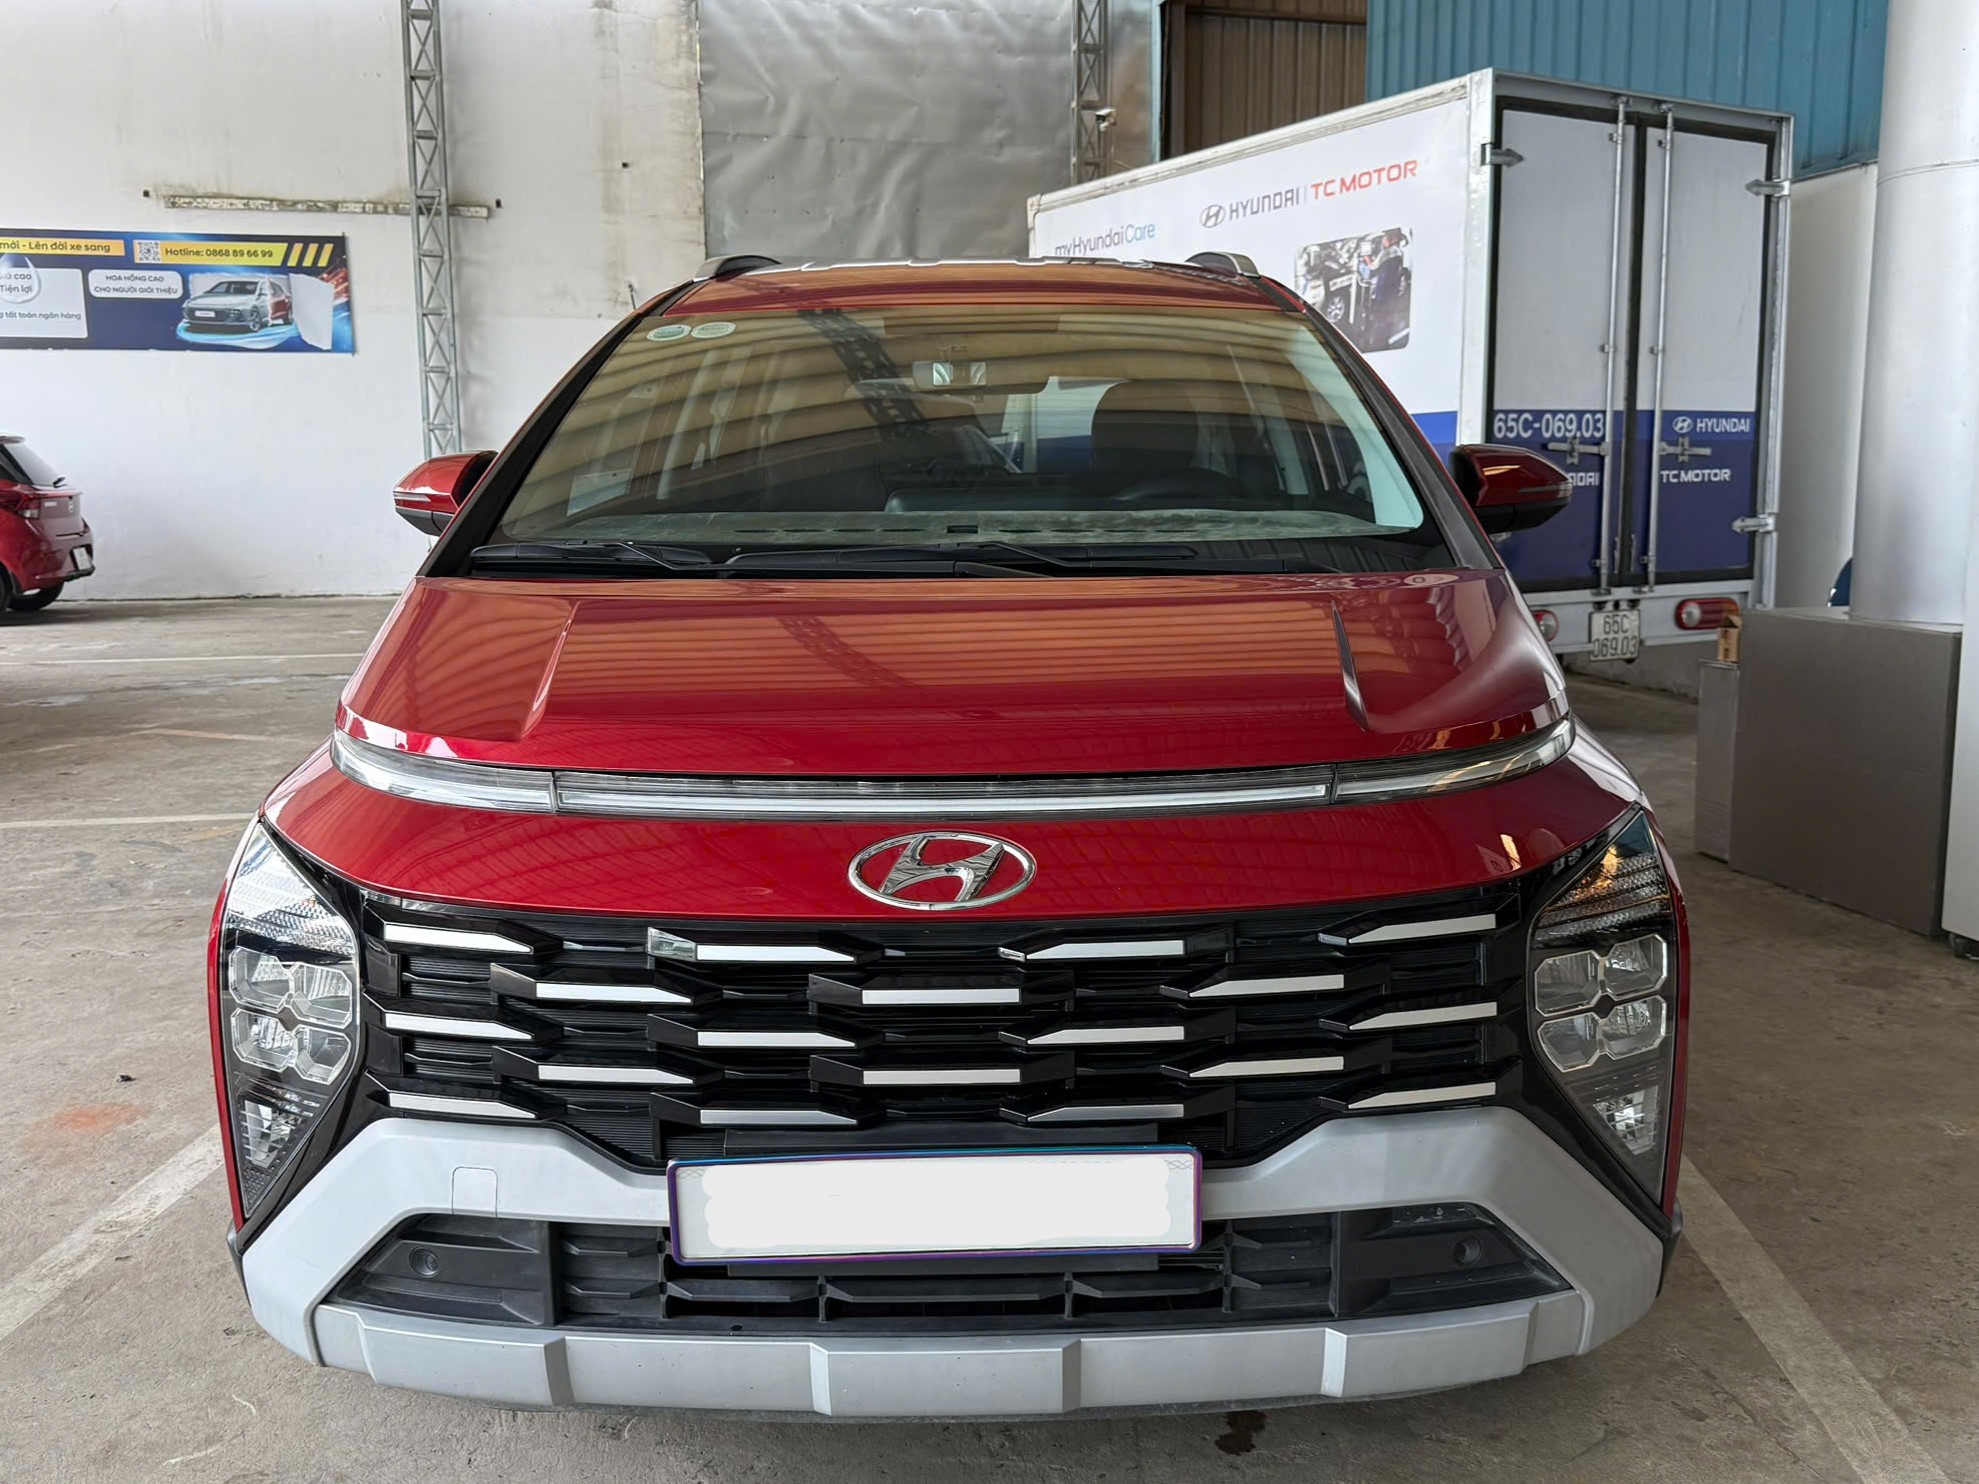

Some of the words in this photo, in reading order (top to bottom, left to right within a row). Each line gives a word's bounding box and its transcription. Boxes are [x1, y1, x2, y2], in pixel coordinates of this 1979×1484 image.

[1229, 187, 1300, 221] HYUNDAI
[1311, 179, 1336, 200] TC
[1340, 160, 1418, 195] MOTOR
[29, 241, 48, 251] Lên
[85, 244, 111, 253] sang
[165, 247, 204, 257] Hotline:
[205, 248, 231, 258] 0868
[232, 249, 245, 258] 89
[246, 249, 259, 258] 66
[260, 249, 273, 259] 99
[106, 274, 123, 282] HOA
[147, 275, 165, 283] CAO
[94, 285, 112, 293] CHO
[1493, 412, 1605, 440] 65C-069.03
[1695, 418, 1751, 433] HYUNDAI
[1660, 470, 1679, 484] TC
[1680, 468, 1732, 483] MOTOR
[1603, 614, 1629, 635] 65C
